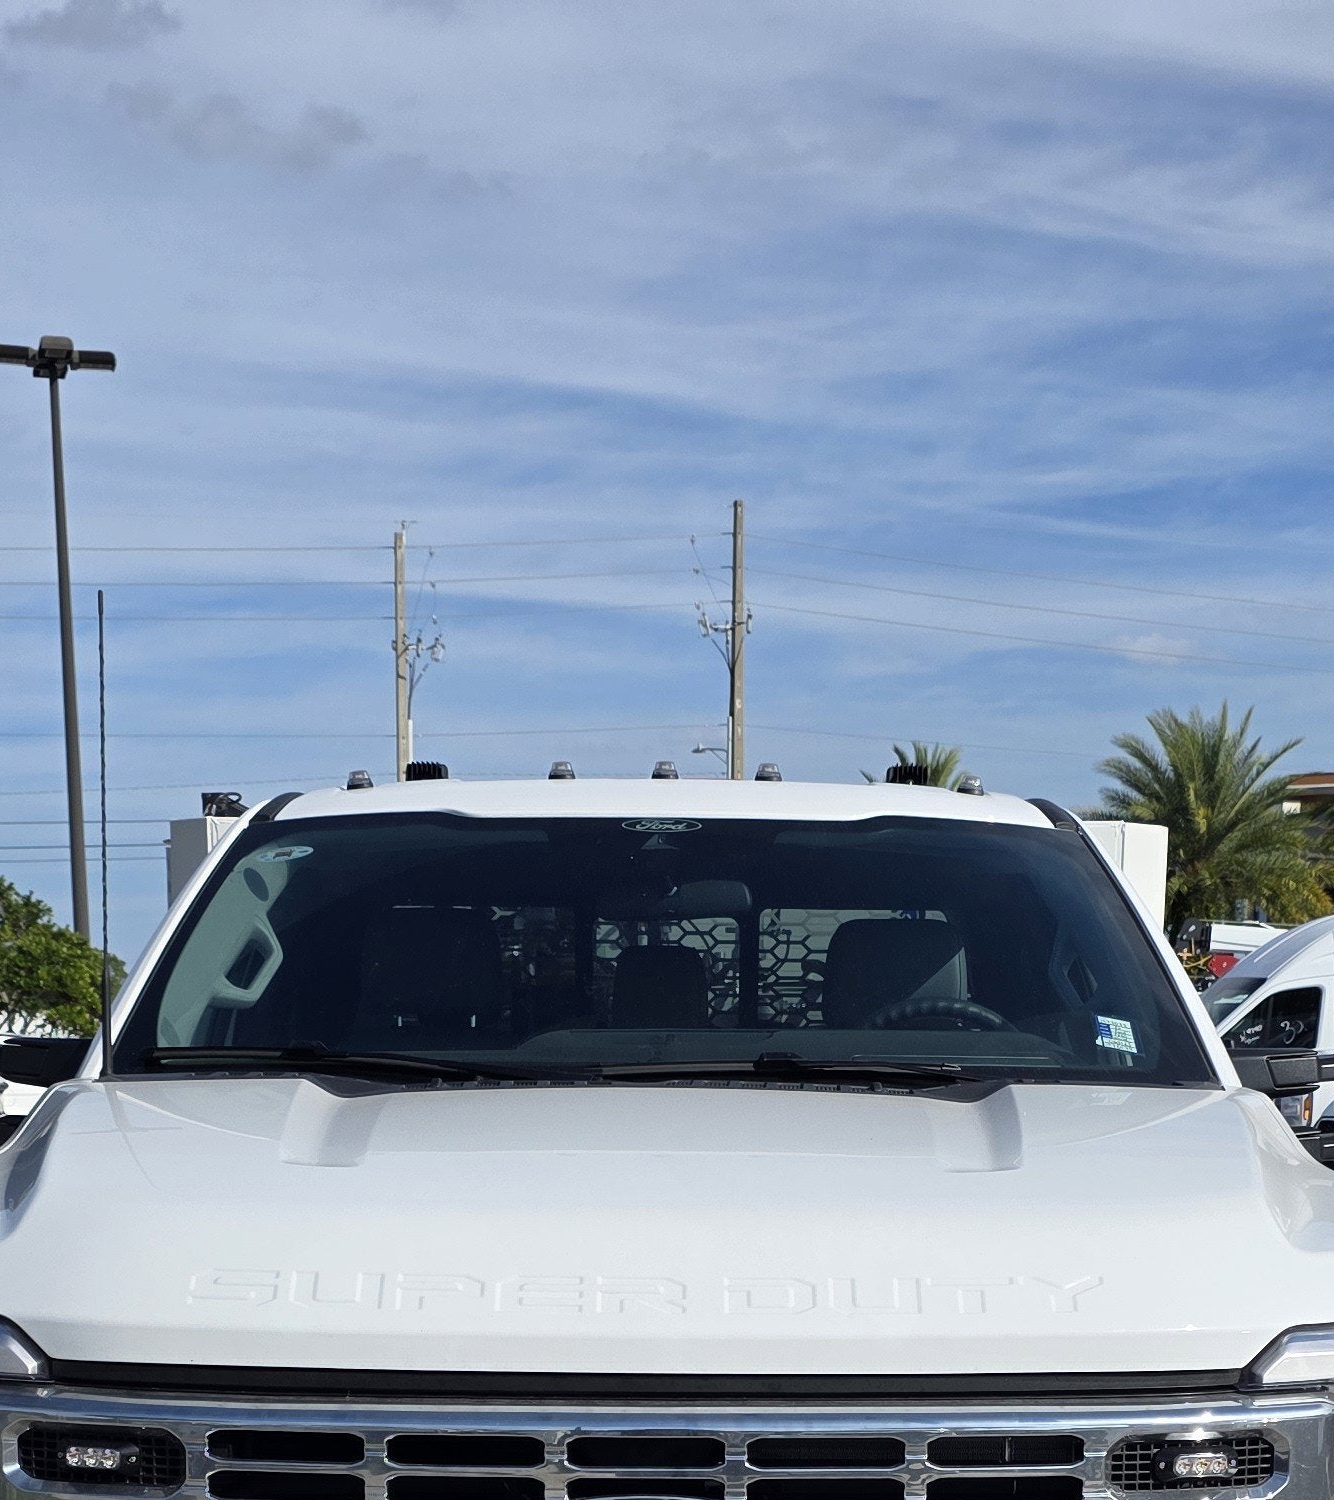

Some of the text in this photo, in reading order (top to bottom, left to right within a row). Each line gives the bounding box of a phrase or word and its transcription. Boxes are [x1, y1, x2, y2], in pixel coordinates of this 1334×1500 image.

[636, 820, 687, 830] Ford
[186, 1268, 1105, 1315] SUPER DUTY
